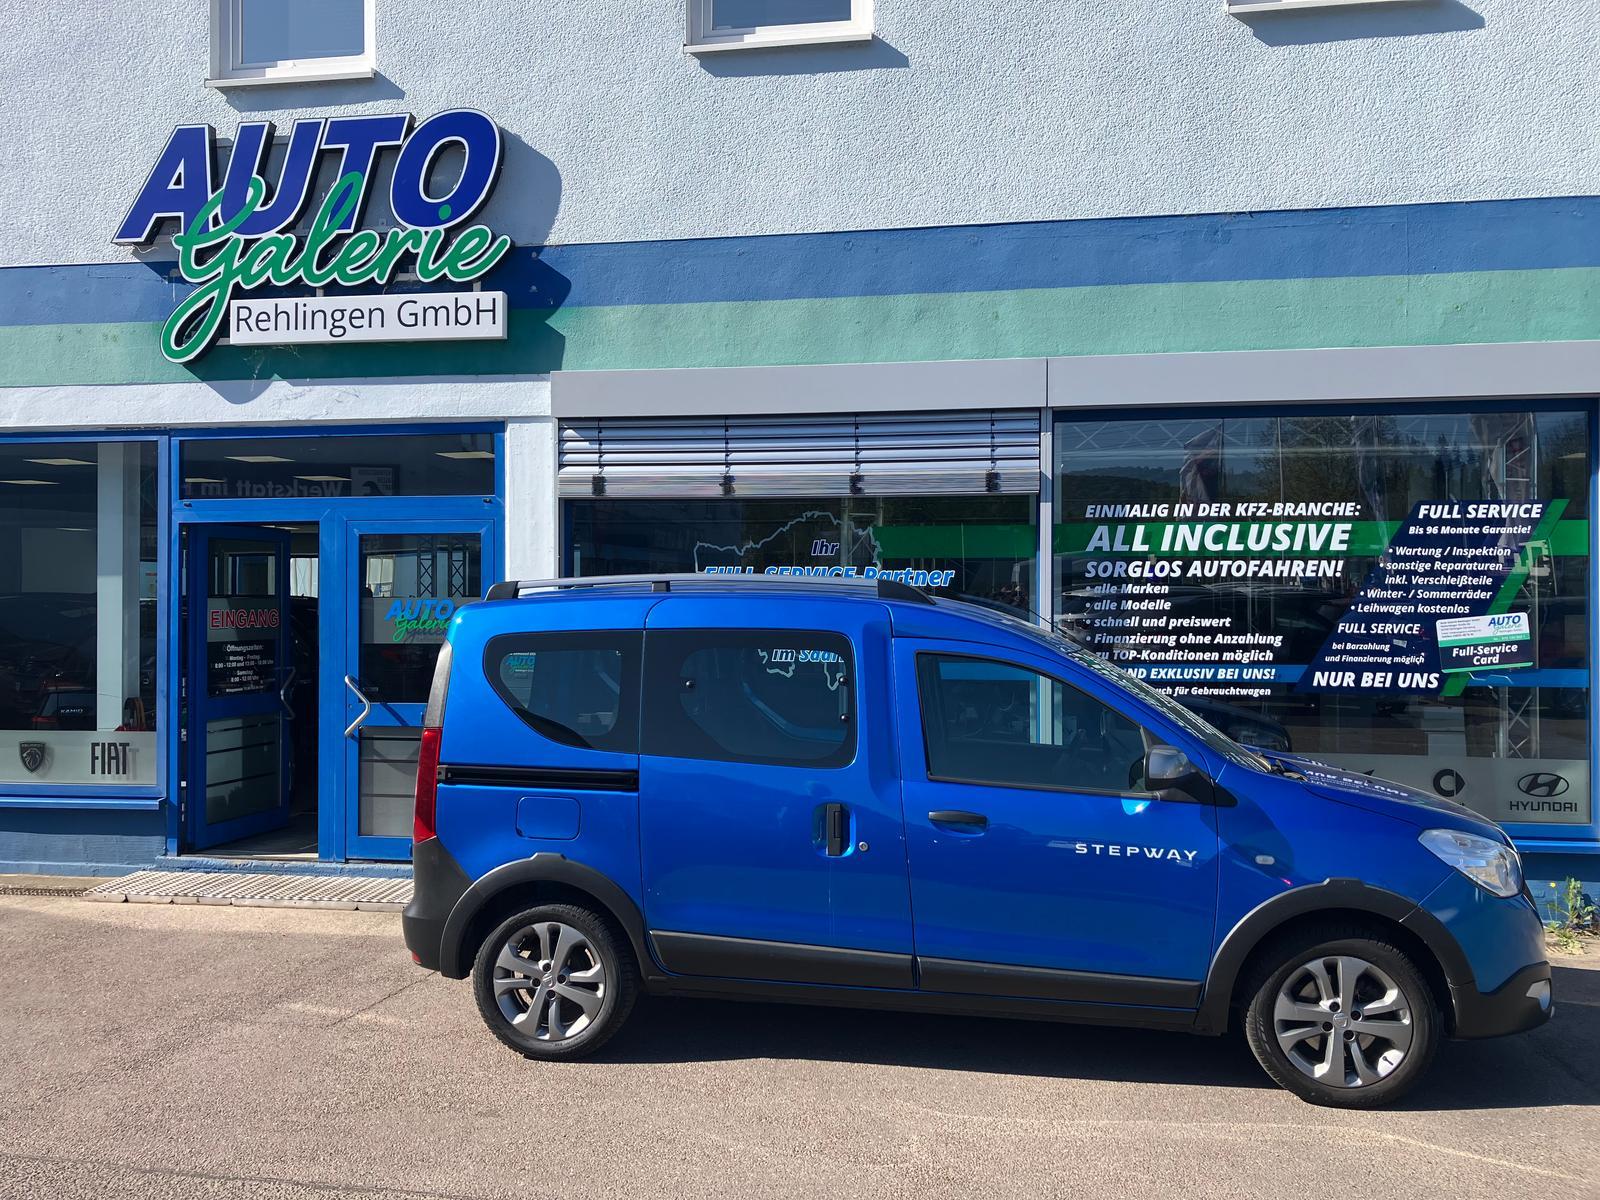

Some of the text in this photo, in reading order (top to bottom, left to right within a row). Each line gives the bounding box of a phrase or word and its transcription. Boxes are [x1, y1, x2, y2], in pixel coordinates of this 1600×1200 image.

[112, 107, 502, 244] AUTO
[160, 170, 511, 363] Galerie
[235, 297, 497, 338] Rehlingen GmbH
[1085, 502, 1361, 518] EINMALIG IN DER KFZ-BRANCHE:
[1418, 504, 1542, 519] FULL SERVICE
[1408, 525, 1531, 534] Bis 96 Monate Garantie!
[1085, 523, 1352, 552] ALL INCLUSIVE
[811, 539, 840, 556] Ihr
[1395, 547, 1442, 557] Wartung
[1452, 546, 1511, 558] Inspektion
[1085, 559, 1344, 578] SORGLOS AUTOFAHREN!
[1386, 561, 1503, 573] sonstige Reparaturen
[1385, 575, 1493, 586] inkl. Verschleißteile
[1093, 583, 1169, 594] alle Marken
[1366, 589, 1406, 599] Winter-
[1416, 588, 1492, 599] Sommerräder
[384, 598, 455, 621] AUTO
[1093, 599, 1171, 610] alle Modelle
[1357, 603, 1470, 614] Leihwagen kostenlos
[210, 609, 279, 629] EINGANG
[1093, 616, 1231, 629] schnell und preiswert
[1488, 615, 1521, 627] AUTO
[1337, 623, 1420, 634] FULL SERVICE
[1094, 632, 1283, 647] Finanzierung ohne Anzahlung
[1332, 642, 1390, 652] bei Barzahlung
[1452, 643, 1518, 657] Full-Service
[1095, 649, 1274, 663] zu TOP-Konditionen möglich
[1341, 655, 1391, 665] Finanzierung
[1393, 655, 1425, 665] möglich
[1473, 654, 1500, 665] Card
[1124, 667, 1276, 680] ND EXKLUSIV BEI UNS!
[1312, 671, 1440, 689] NUR BEI UNS
[1155, 686, 1271, 698] uch für Gebrauchtwagen
[90, 742, 130, 775] FIAT
[1509, 800, 1578, 812] HYUNDAI
[1075, 843, 1198, 861] STEPWAY
